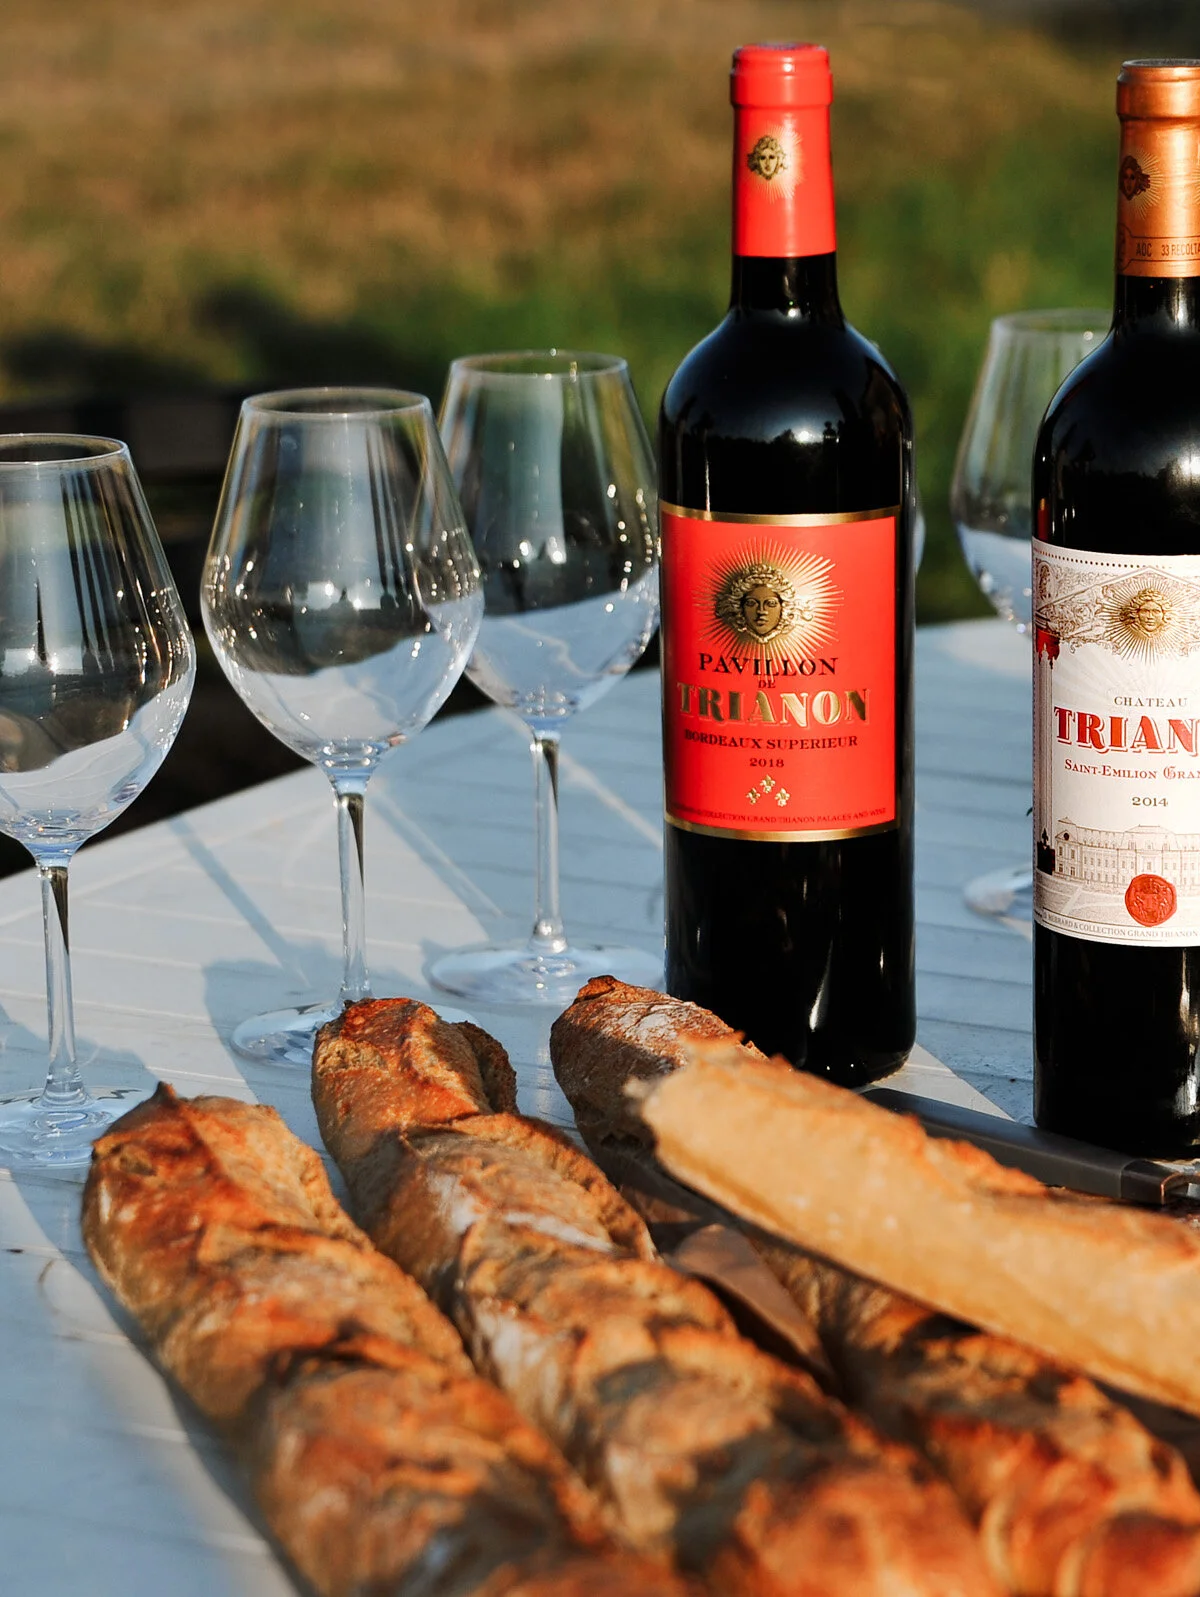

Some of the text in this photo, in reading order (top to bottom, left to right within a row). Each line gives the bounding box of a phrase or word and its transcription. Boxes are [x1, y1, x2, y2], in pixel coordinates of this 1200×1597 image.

[1136, 243, 1152, 257] AOC
[1160, 244, 1170, 256] 33
[698, 653, 839, 676] PAVILLON
[758, 680, 776, 689] DE
[677, 682, 871, 729] TRIANON
[1113, 696, 1188, 708] CHATEAU
[684, 729, 858, 750] BORDEAUX SUPERIEUR
[749, 757, 785, 768] 2018
[1131, 796, 1169, 807] 2014
[747, 815, 778, 823] GRAND
[1079, 923, 1126, 936] COLLECTION
[1127, 929, 1159, 938] GRAND
[1160, 930, 1198, 938] TRIANON
